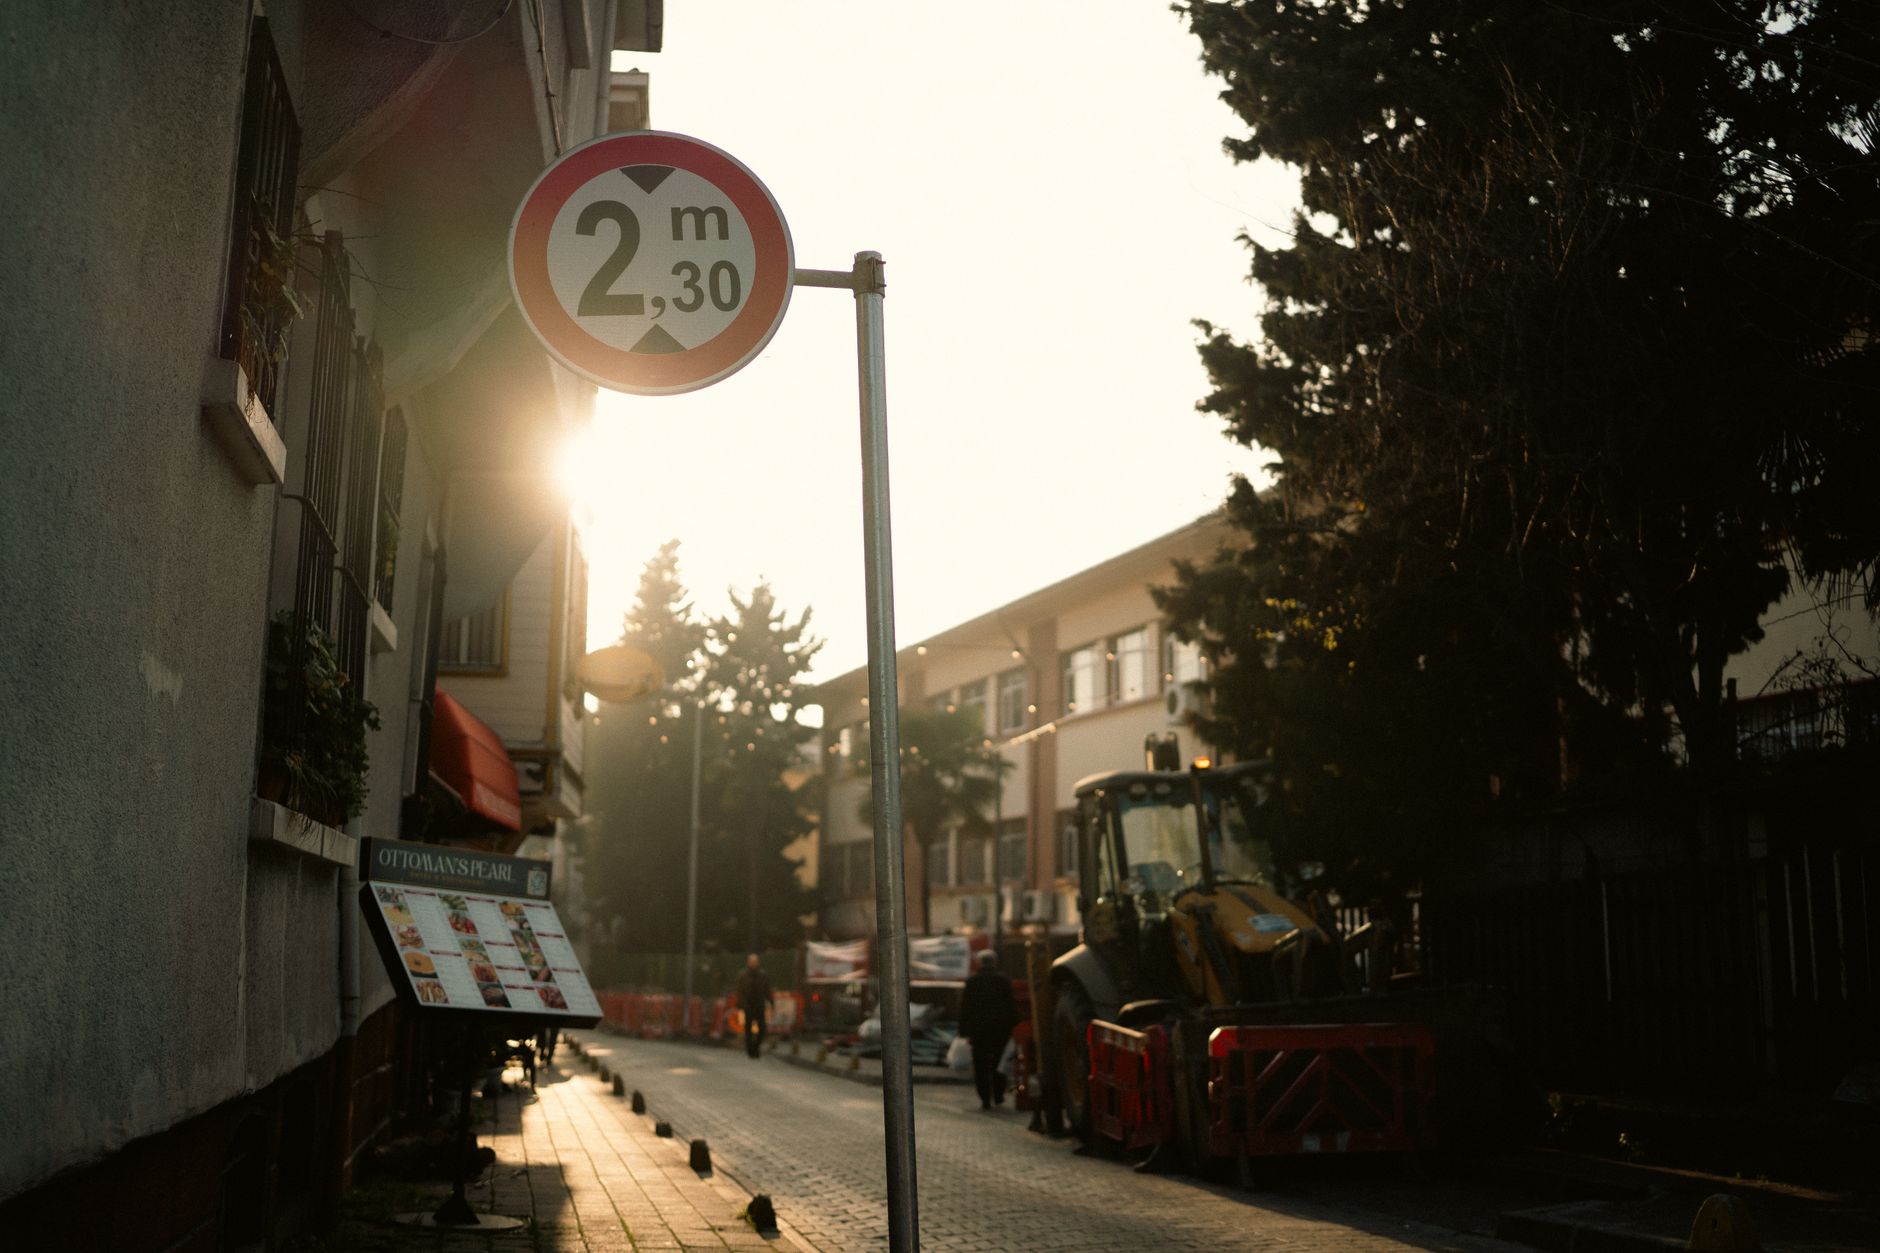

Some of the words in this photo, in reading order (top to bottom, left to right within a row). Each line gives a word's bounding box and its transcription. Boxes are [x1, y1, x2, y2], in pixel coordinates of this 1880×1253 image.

[670, 205, 730, 241] m
[379, 847, 468, 876] OTTOMAN'S
[470, 859, 515, 882] PEARL
